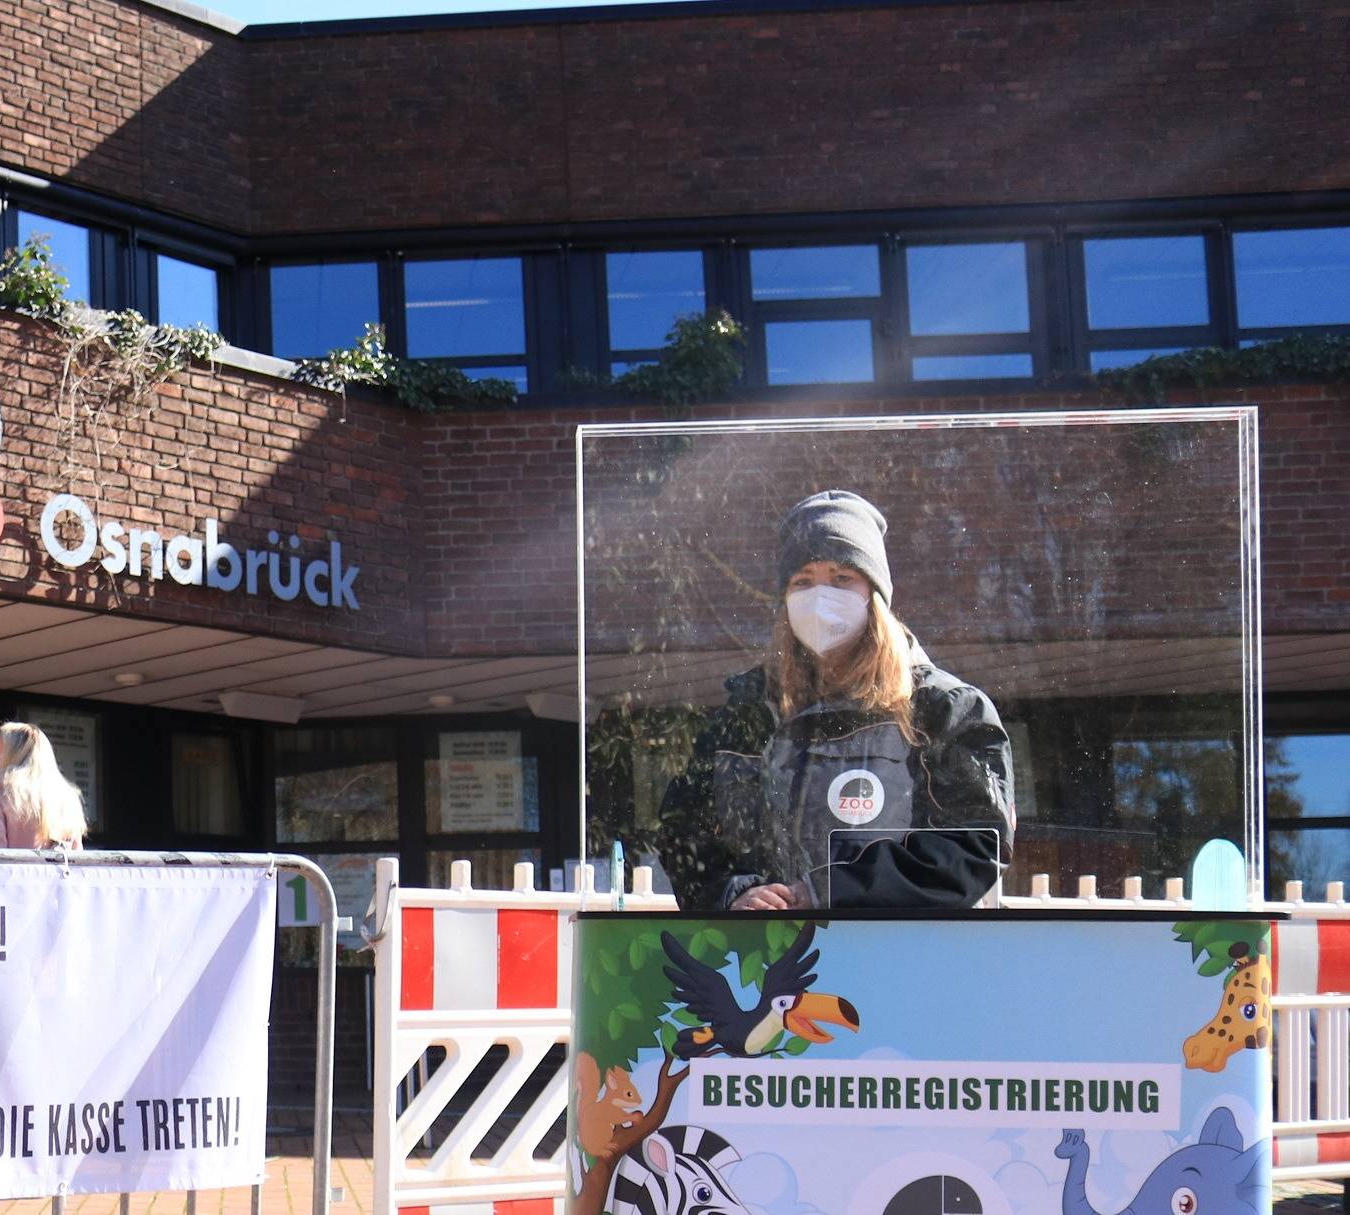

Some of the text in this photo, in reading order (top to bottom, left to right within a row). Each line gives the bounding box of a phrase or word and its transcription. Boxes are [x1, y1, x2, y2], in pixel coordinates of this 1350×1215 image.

[40, 493, 361, 609] Osnabrück
[839, 798, 873, 810] ZOO
[285, 874, 308, 922] 1
[702, 1074, 1159, 1114] BESUCHERREGISTRIERUNG
[47, 1100, 127, 1156] KASSE
[135, 1095, 241, 1152] TRETEN!
